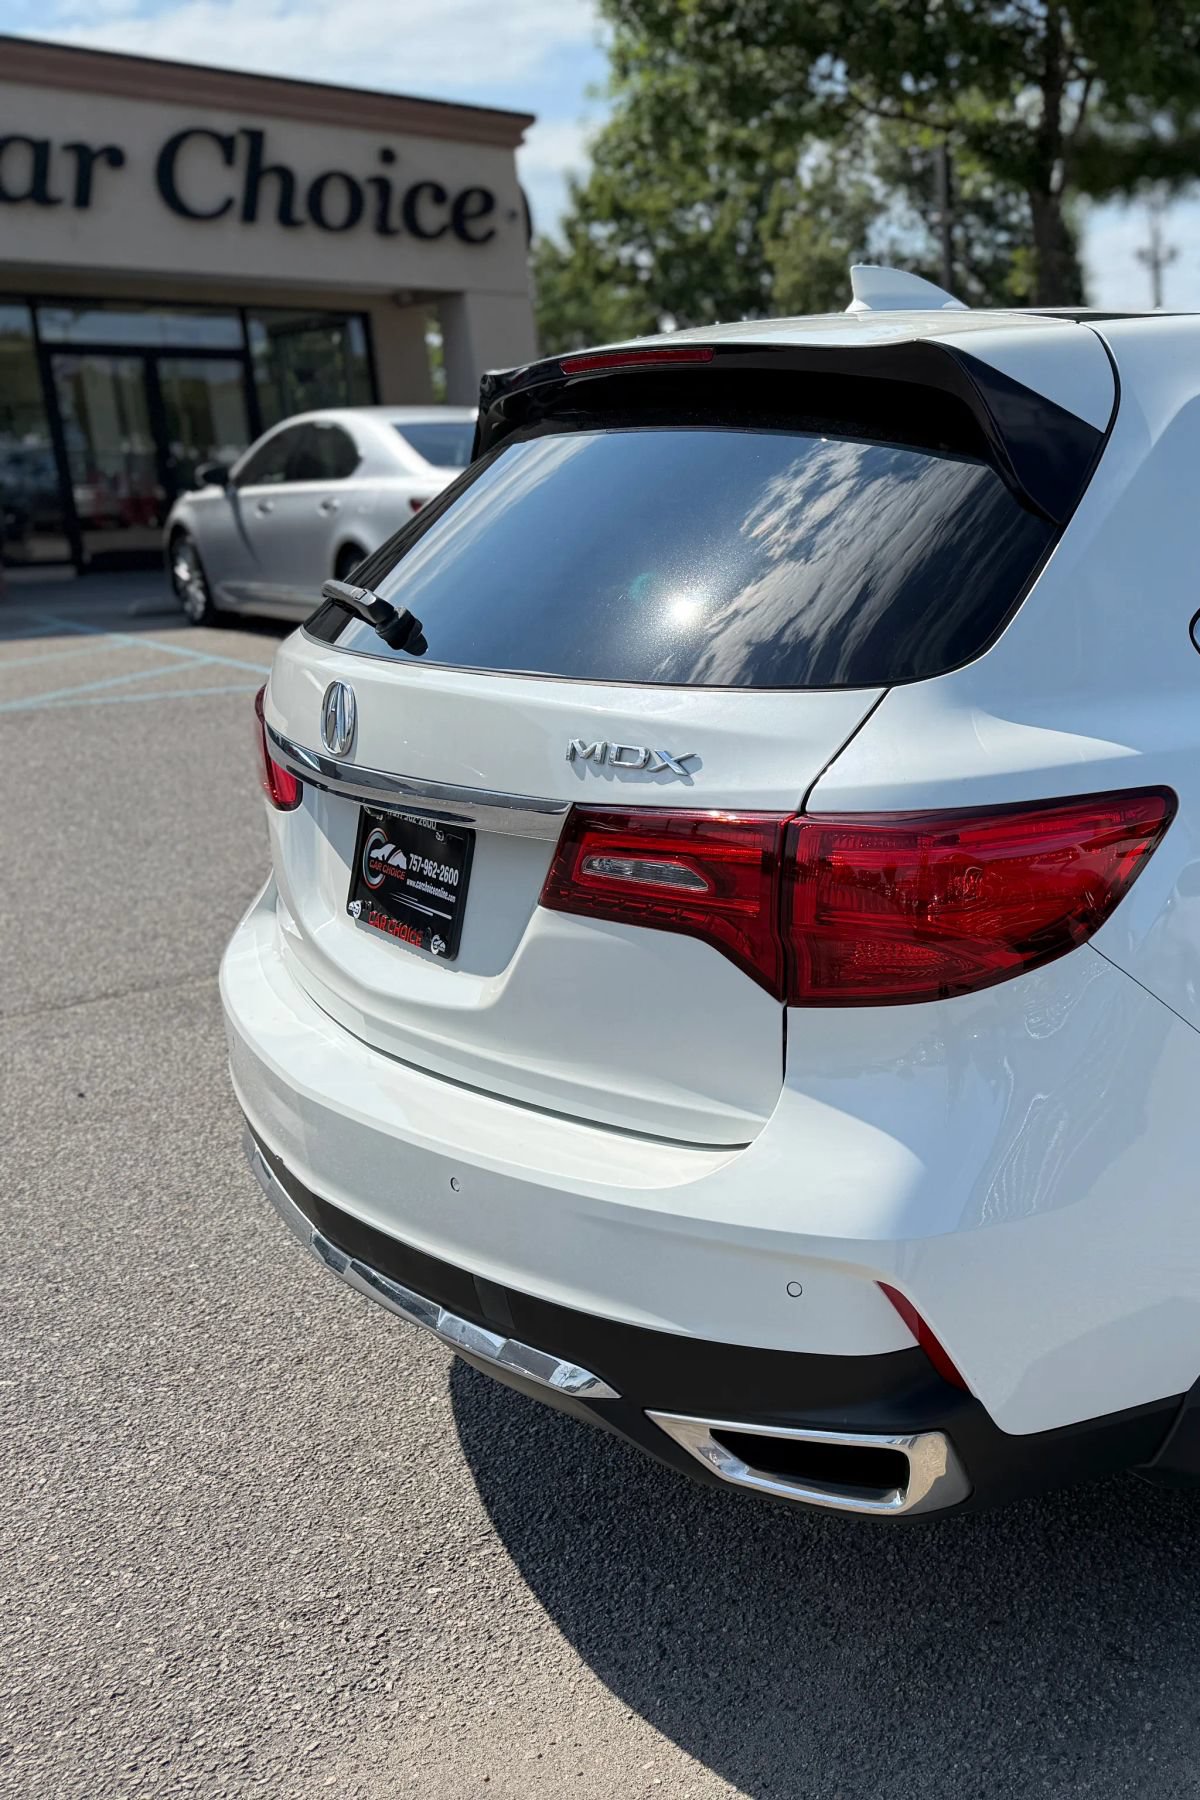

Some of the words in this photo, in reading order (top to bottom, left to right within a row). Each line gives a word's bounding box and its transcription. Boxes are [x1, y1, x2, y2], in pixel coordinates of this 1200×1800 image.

[154, 126, 497, 244] Choice
[566, 739, 698, 776] MDX
[369, 859, 383, 872] CAR
[382, 864, 406, 881] CHOICE
[408, 853, 459, 887] 757-962-2600
[368, 910, 388, 932] CAR
[388, 918, 424, 949] CHOICE
